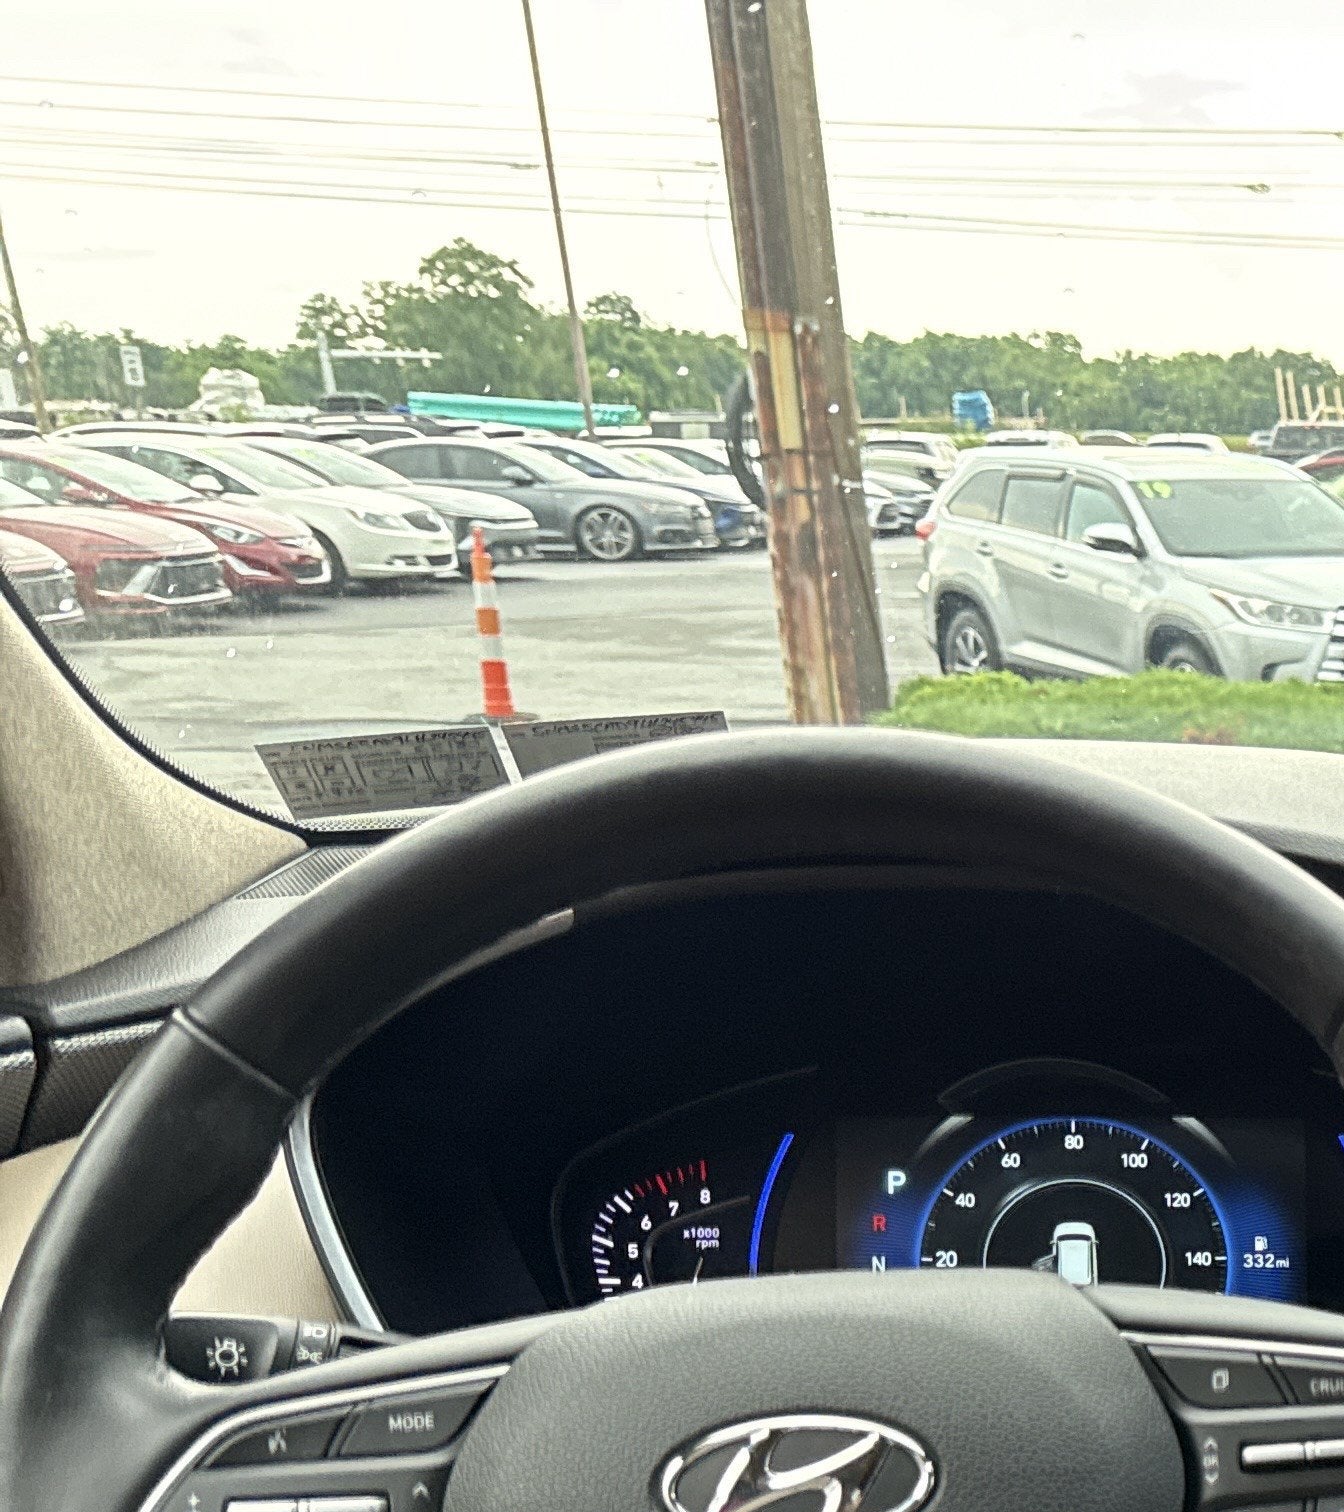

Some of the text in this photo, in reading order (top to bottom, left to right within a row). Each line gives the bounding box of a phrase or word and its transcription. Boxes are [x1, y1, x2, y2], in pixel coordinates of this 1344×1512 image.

[1064, 1134, 1085, 1150] 80
[1001, 1152, 1021, 1168] 60
[1121, 1153, 1149, 1169] 100
[887, 1170, 907, 1195] P
[699, 1187, 711, 1205] 8
[955, 1192, 976, 1208] 40
[1164, 1192, 1192, 1208] 120
[668, 1200, 680, 1217] 7
[640, 1214, 652, 1231] 6
[872, 1213, 887, 1232] R
[627, 1242, 639, 1259] 5
[695, 1239, 720, 1251] rpm
[871, 1255, 886, 1273] N
[935, 1250, 958, 1268] 20
[1185, 1251, 1212, 1267] 140
[631, 1272, 644, 1289] 4
[388, 1411, 435, 1433] MODE
